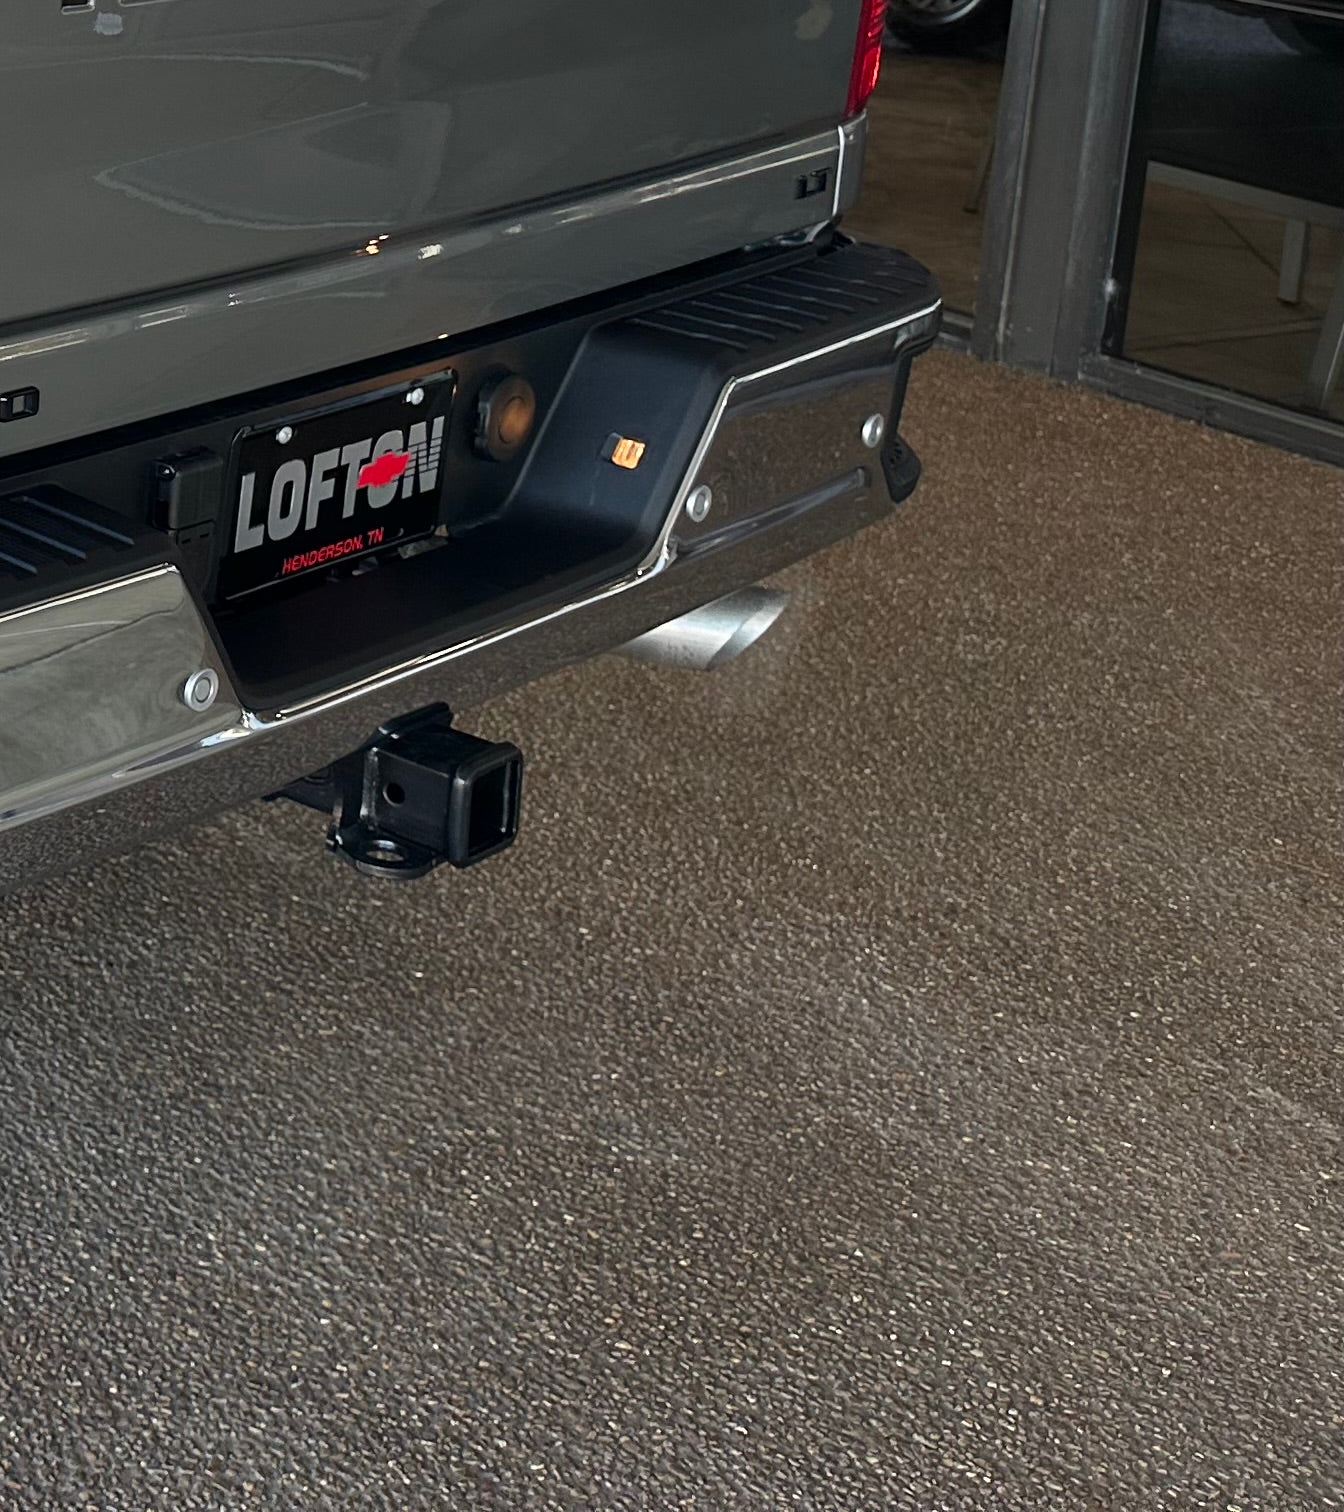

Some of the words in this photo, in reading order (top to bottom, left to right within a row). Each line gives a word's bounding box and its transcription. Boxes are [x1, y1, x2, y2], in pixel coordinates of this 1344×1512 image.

[794, 167, 832, 200] LT
[234, 415, 446, 554] LOFTON
[367, 527, 385, 547] TN
